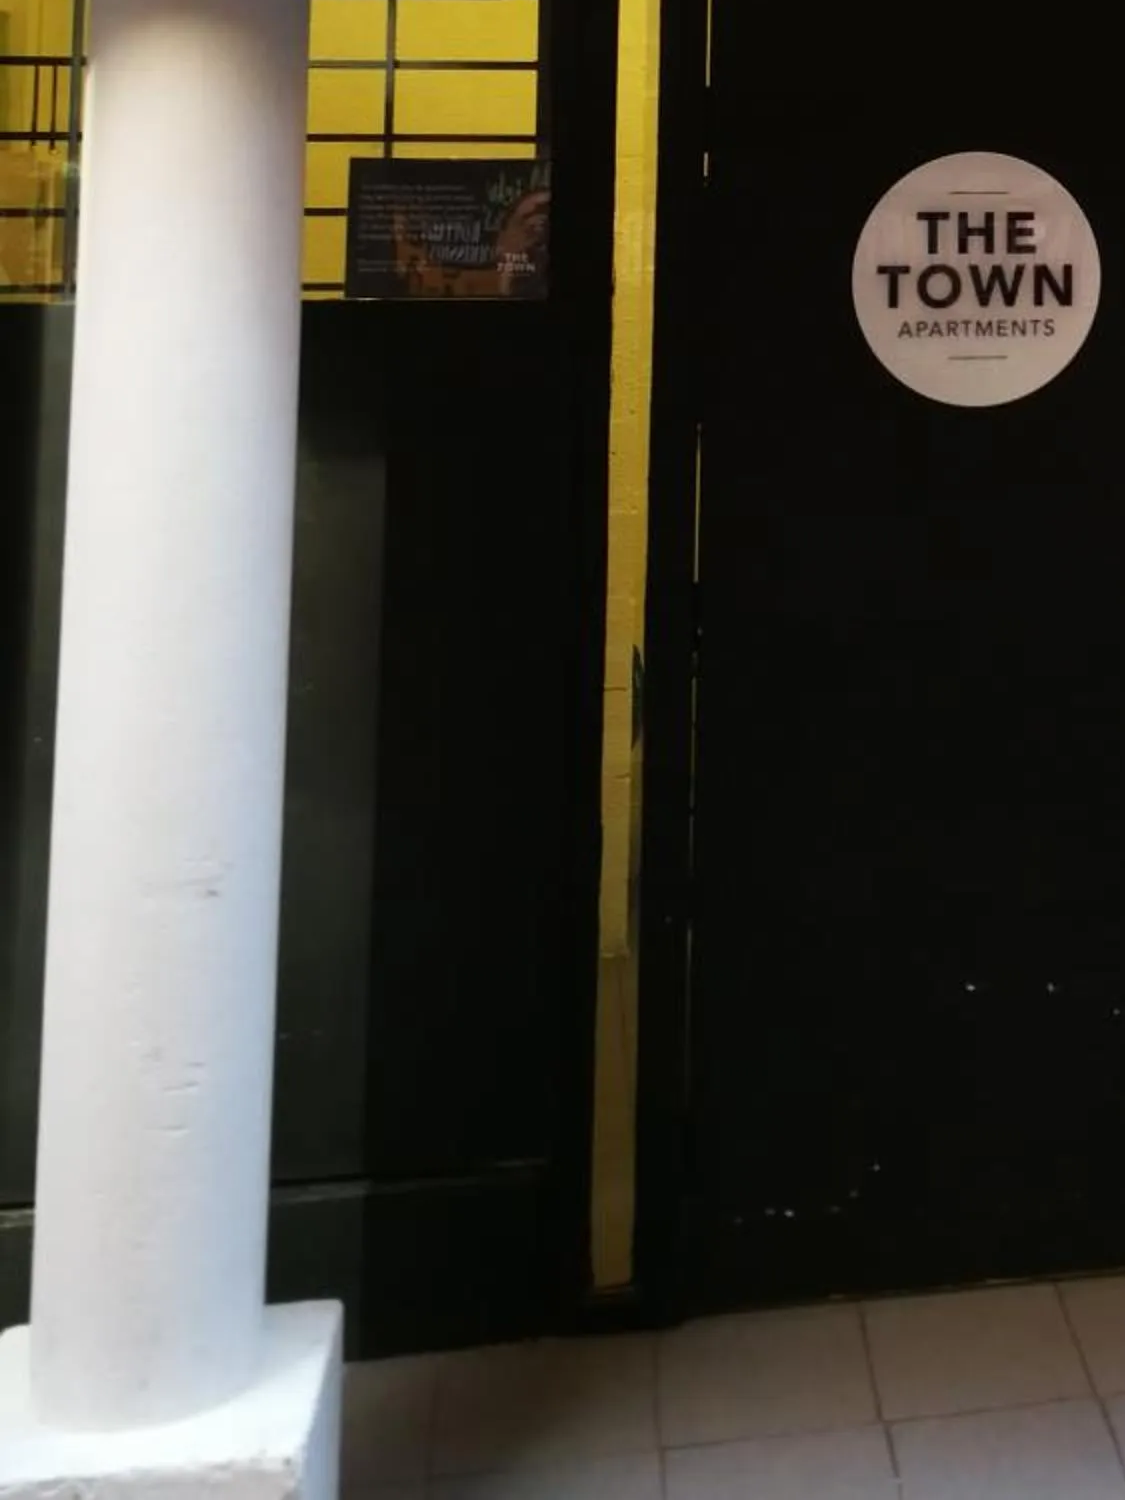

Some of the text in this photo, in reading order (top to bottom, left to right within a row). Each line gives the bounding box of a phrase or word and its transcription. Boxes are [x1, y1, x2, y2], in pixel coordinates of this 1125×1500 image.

[916, 211, 1038, 256] THE
[876, 263, 1074, 310] TOWN
[897, 318, 1056, 339] APARTMENTS
